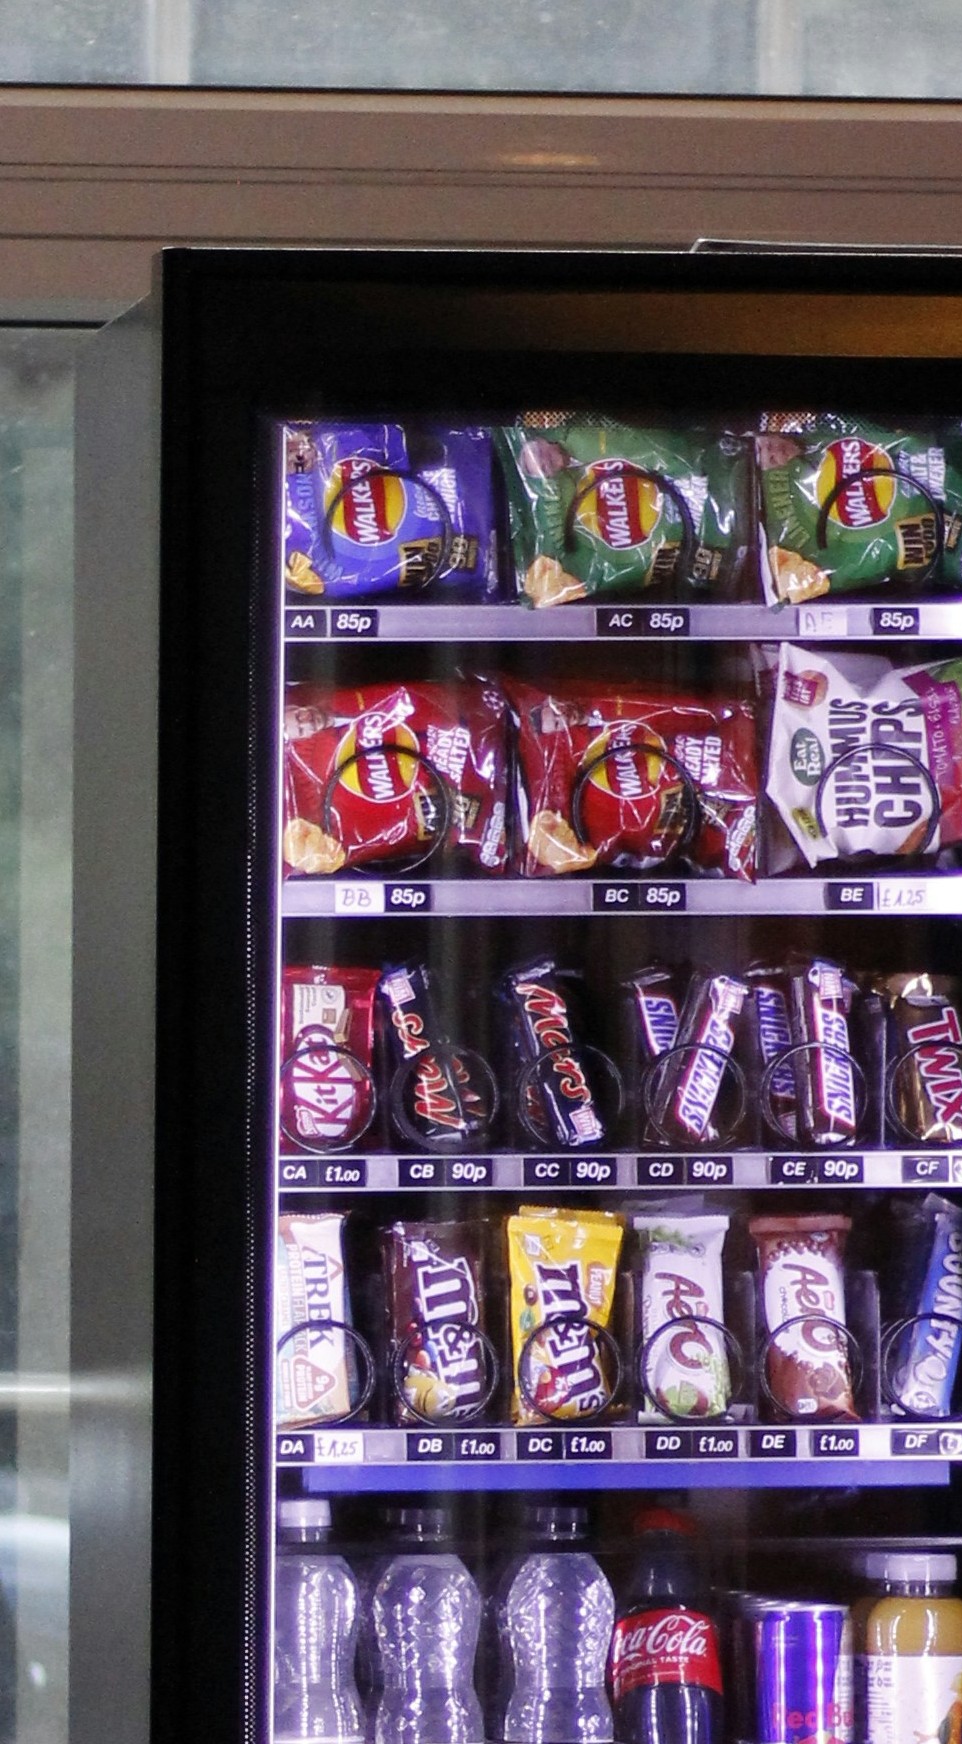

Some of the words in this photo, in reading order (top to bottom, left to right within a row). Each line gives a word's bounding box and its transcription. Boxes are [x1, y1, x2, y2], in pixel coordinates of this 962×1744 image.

[290, 615, 315, 629] AA
[336, 613, 372, 633] 85p
[608, 614, 634, 628] AC
[649, 612, 684, 632] 85p
[880, 612, 915, 631] 85p
[793, 740, 808, 771] Eat
[806, 737, 822, 777] Real
[828, 697, 873, 829] HUMMUS
[871, 697, 924, 829] CHIPS
[342, 888, 372, 908] BB
[390, 888, 426, 906] 85p
[604, 888, 629, 903] BC
[646, 888, 681, 907] 85p
[840, 887, 864, 902] BE
[822, 973, 839, 996] WIN
[515, 983, 592, 1104] Mars
[820, 1011, 853, 1121] SNICKERS
[282, 1165, 307, 1180] CA
[325, 1166, 360, 1183] £1.00
[409, 1164, 434, 1178] CB
[451, 1163, 487, 1182] 90p
[534, 1163, 560, 1178] CC
[575, 1162, 611, 1182] 90p
[648, 1162, 674, 1177] CD
[692, 1160, 727, 1179] 90p
[782, 1161, 807, 1176] CE
[824, 1159, 859, 1178] 90p
[915, 1161, 940, 1175] CF
[303, 1253, 335, 1349] TREK
[781, 1262, 842, 1353] Aero
[654, 1271, 715, 1370] Aero
[280, 1440, 304, 1454] DA
[315, 1438, 357, 1458] £1.25
[417, 1439, 443, 1453] DB
[460, 1439, 496, 1456] £1.00
[528, 1438, 553, 1452] DC
[570, 1438, 606, 1454] £1.00
[656, 1436, 681, 1450] DD
[699, 1436, 734, 1452] £1.00
[761, 1435, 785, 1449] DE
[819, 1435, 855, 1452] £1.00
[904, 1434, 928, 1448] DF
[660, 1656, 690, 1664] TASTE
